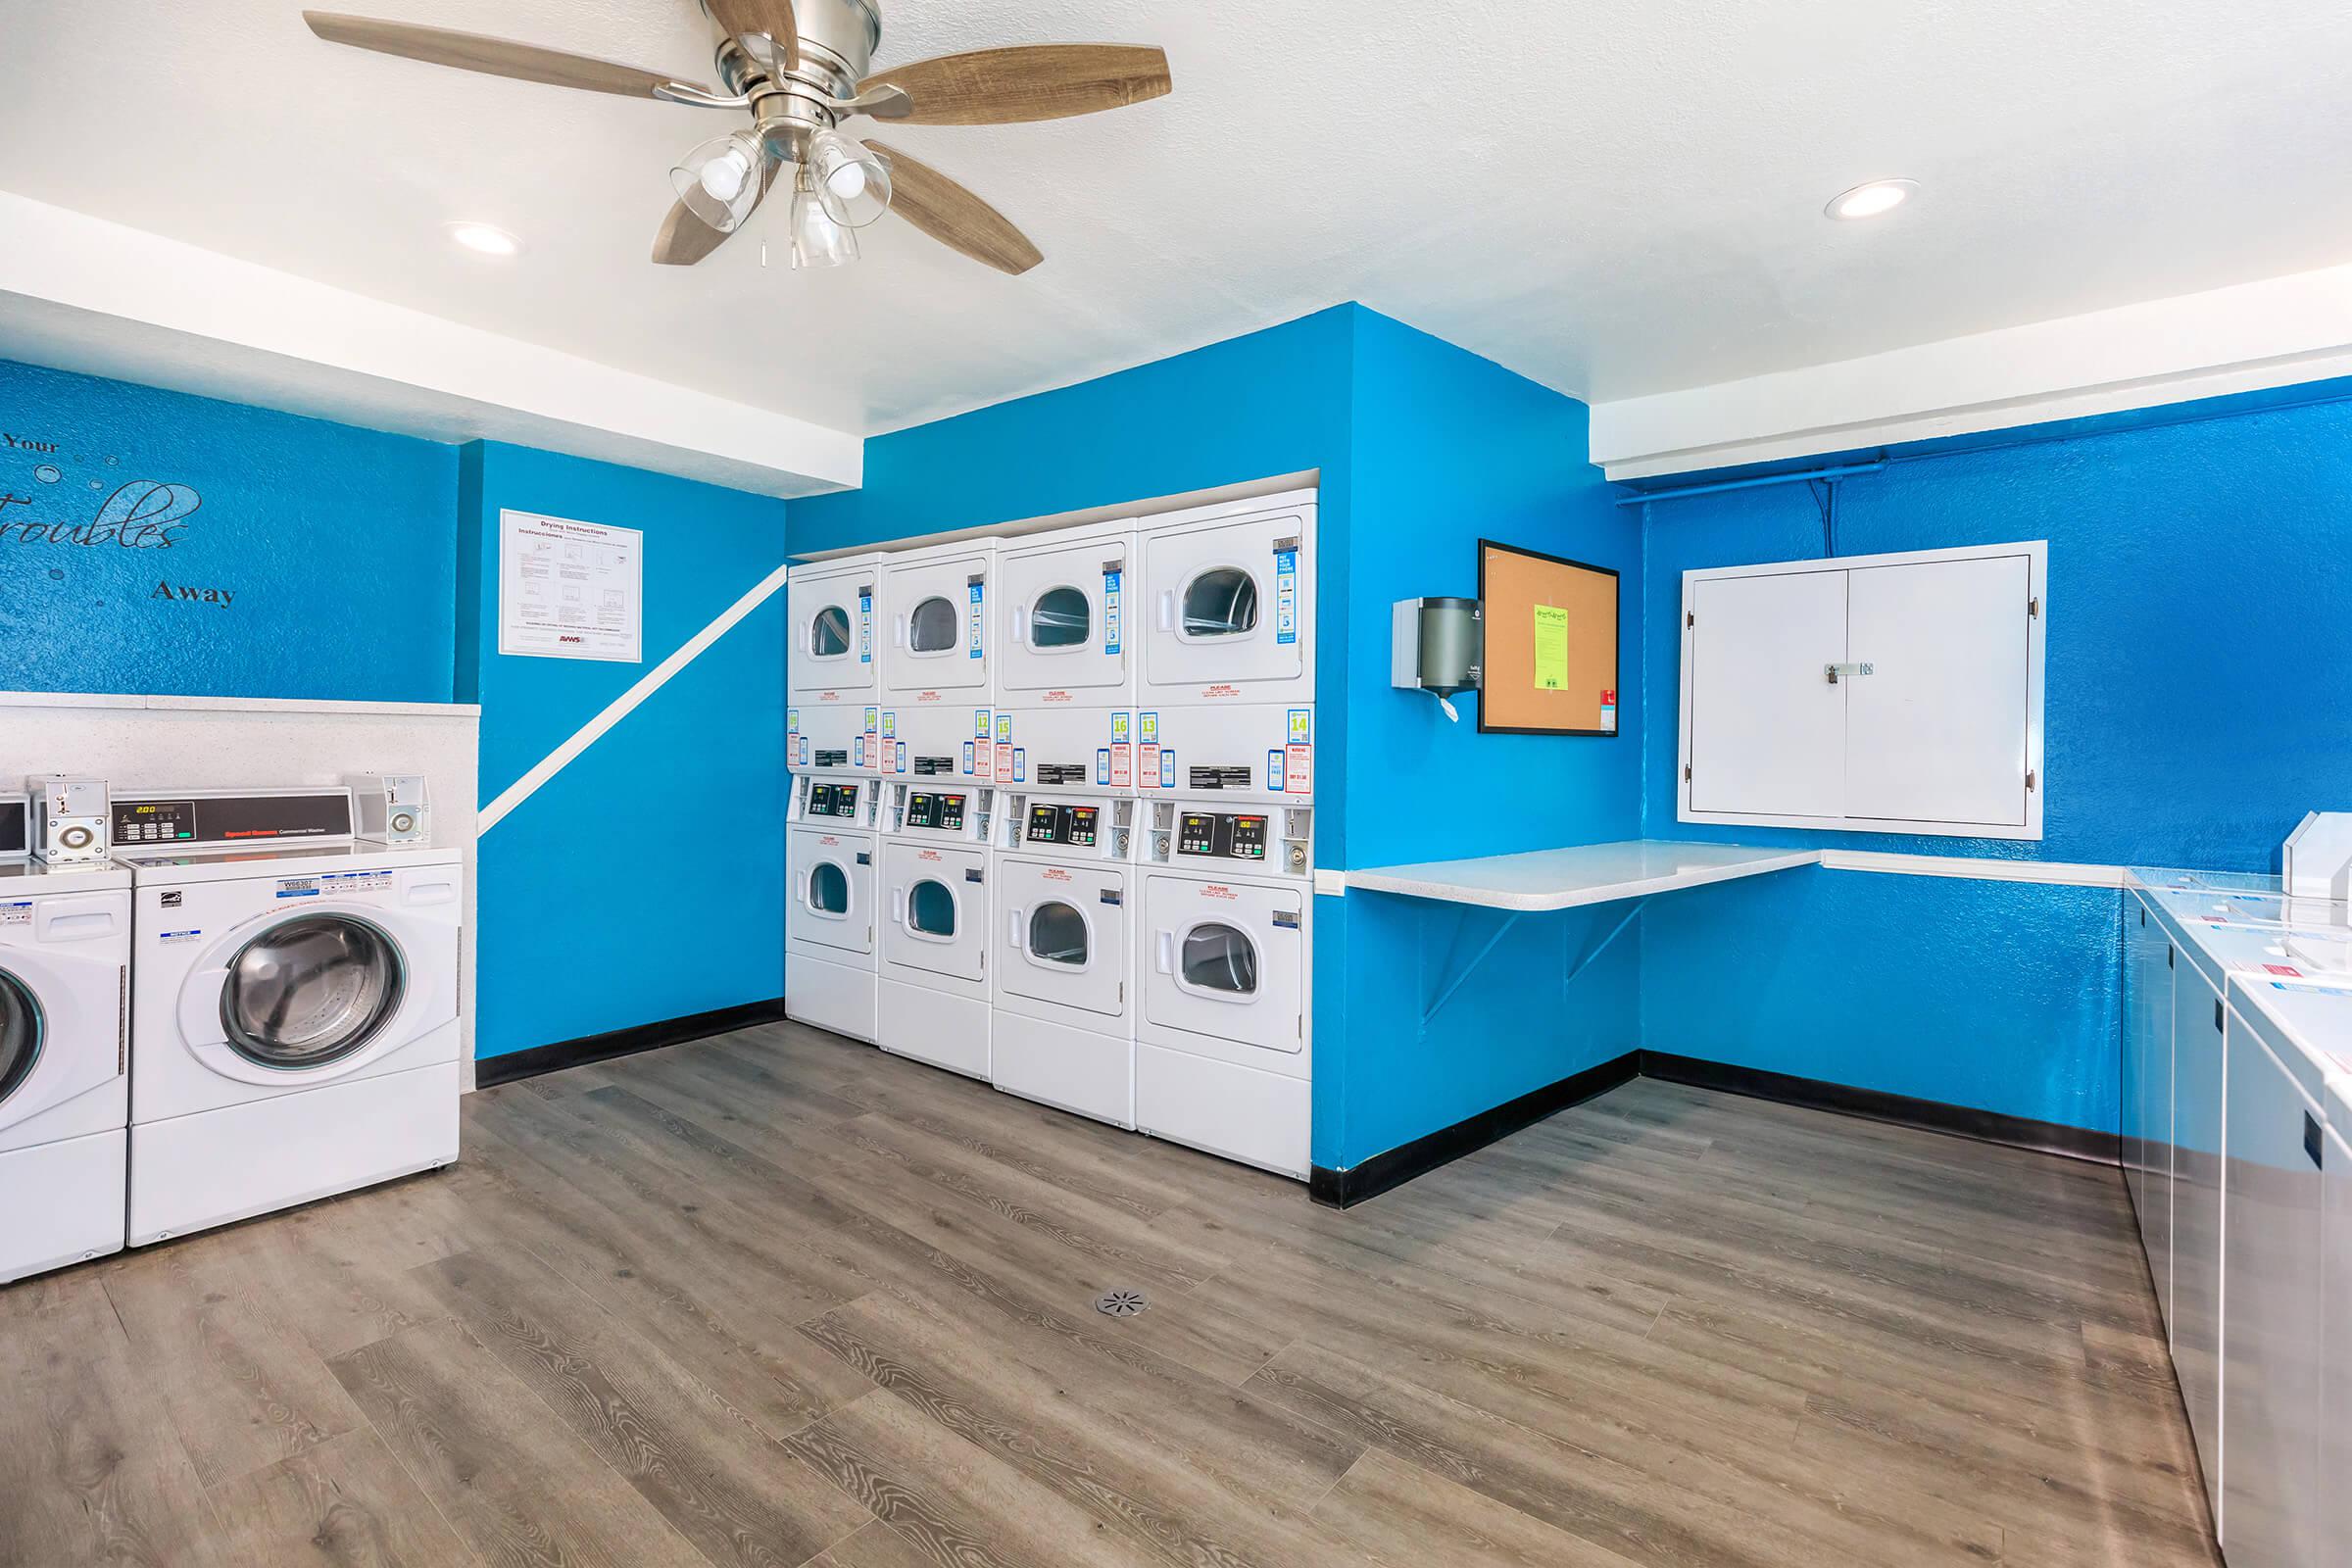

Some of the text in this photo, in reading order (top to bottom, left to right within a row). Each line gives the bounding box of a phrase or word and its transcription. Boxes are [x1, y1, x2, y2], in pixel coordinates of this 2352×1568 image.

[3, 432, 60, 454] Your
[541, 520, 564, 530] Drying
[565, 525, 608, 536] Instructions
[151, 580, 236, 610] Away
[867, 713, 875, 724] 10
[884, 718, 893, 729] 11
[978, 716, 988, 728] 12
[1292, 717, 1307, 731] 14
[999, 721, 1009, 733] 15
[1114, 719, 1127, 732] 16
[1143, 719, 1155, 732] 13
